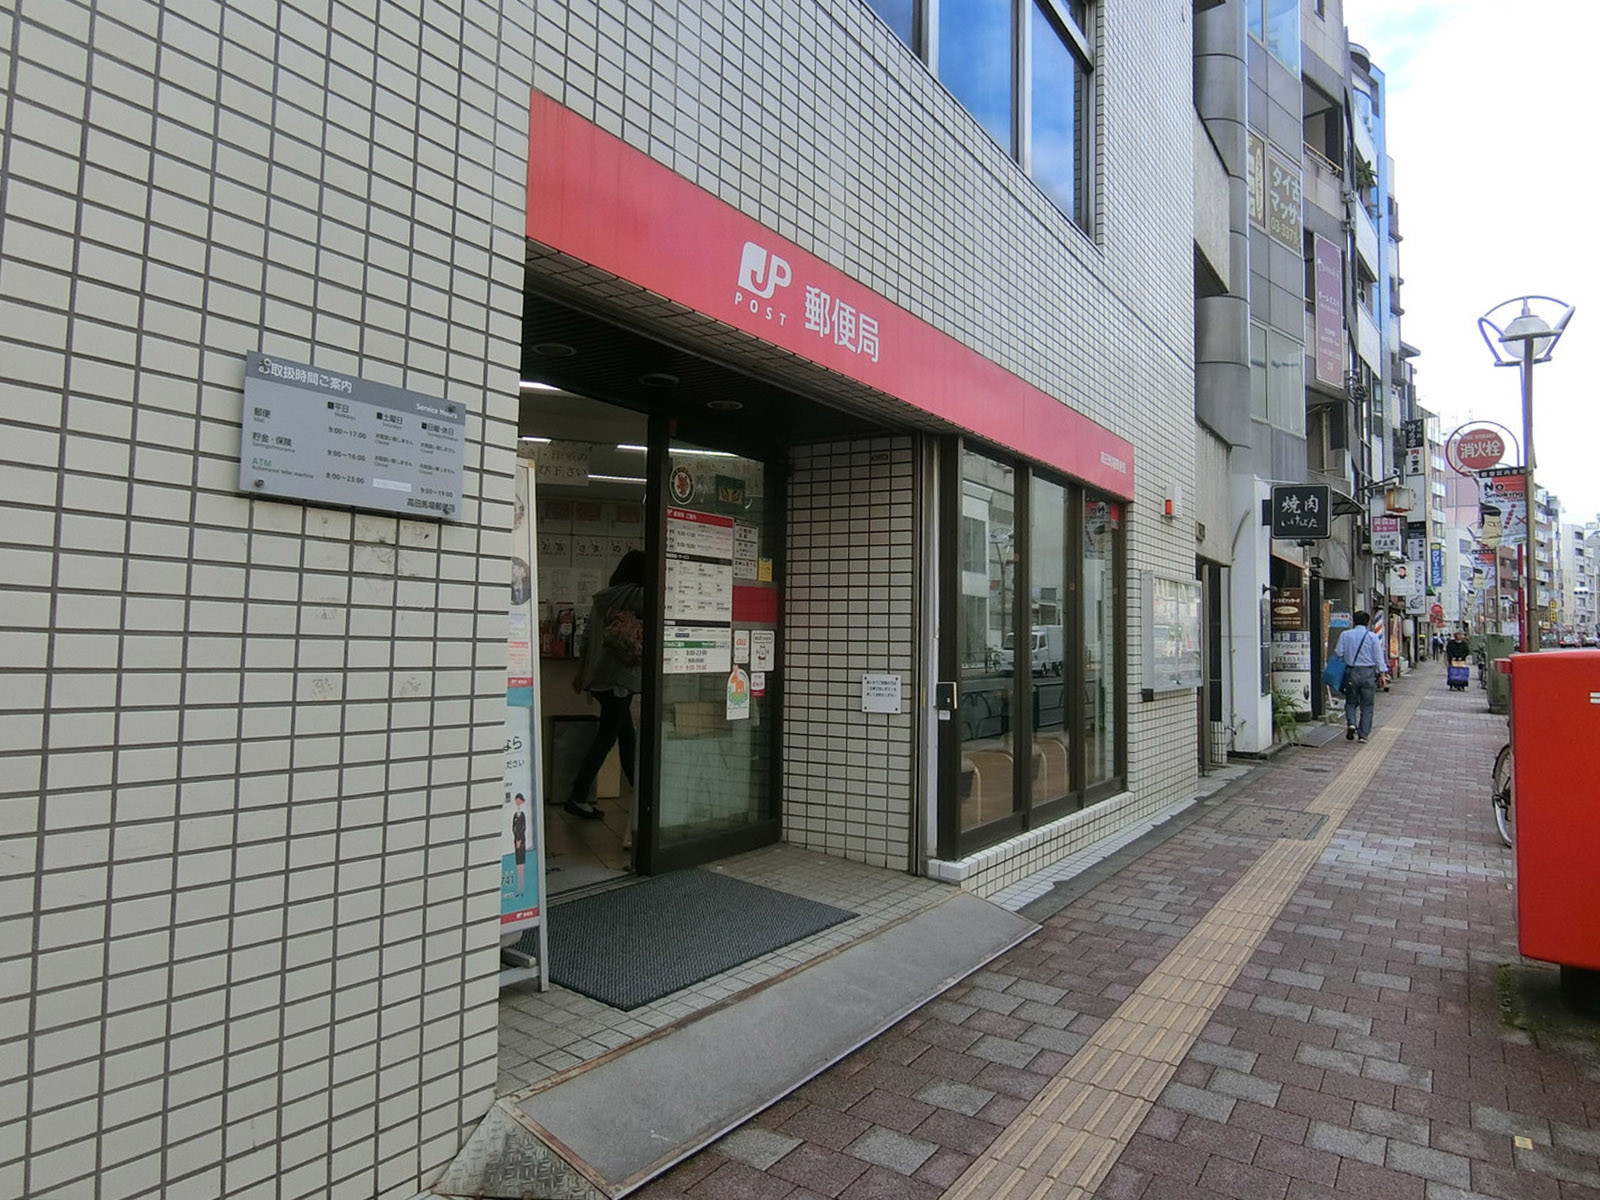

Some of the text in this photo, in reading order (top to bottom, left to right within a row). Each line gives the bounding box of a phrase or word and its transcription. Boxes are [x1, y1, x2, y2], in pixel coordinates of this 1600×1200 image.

[734, 292, 786, 326] POST
[805, 285, 879, 363] 郵便局
[254, 407, 271, 419] 郵便
[334, 402, 349, 413] 平日
[416, 403, 438, 414] Service
[1460, 440, 1500, 459] 消火栓
[252, 458, 272, 467] ATM
[1281, 494, 1319, 514] 焼肉
